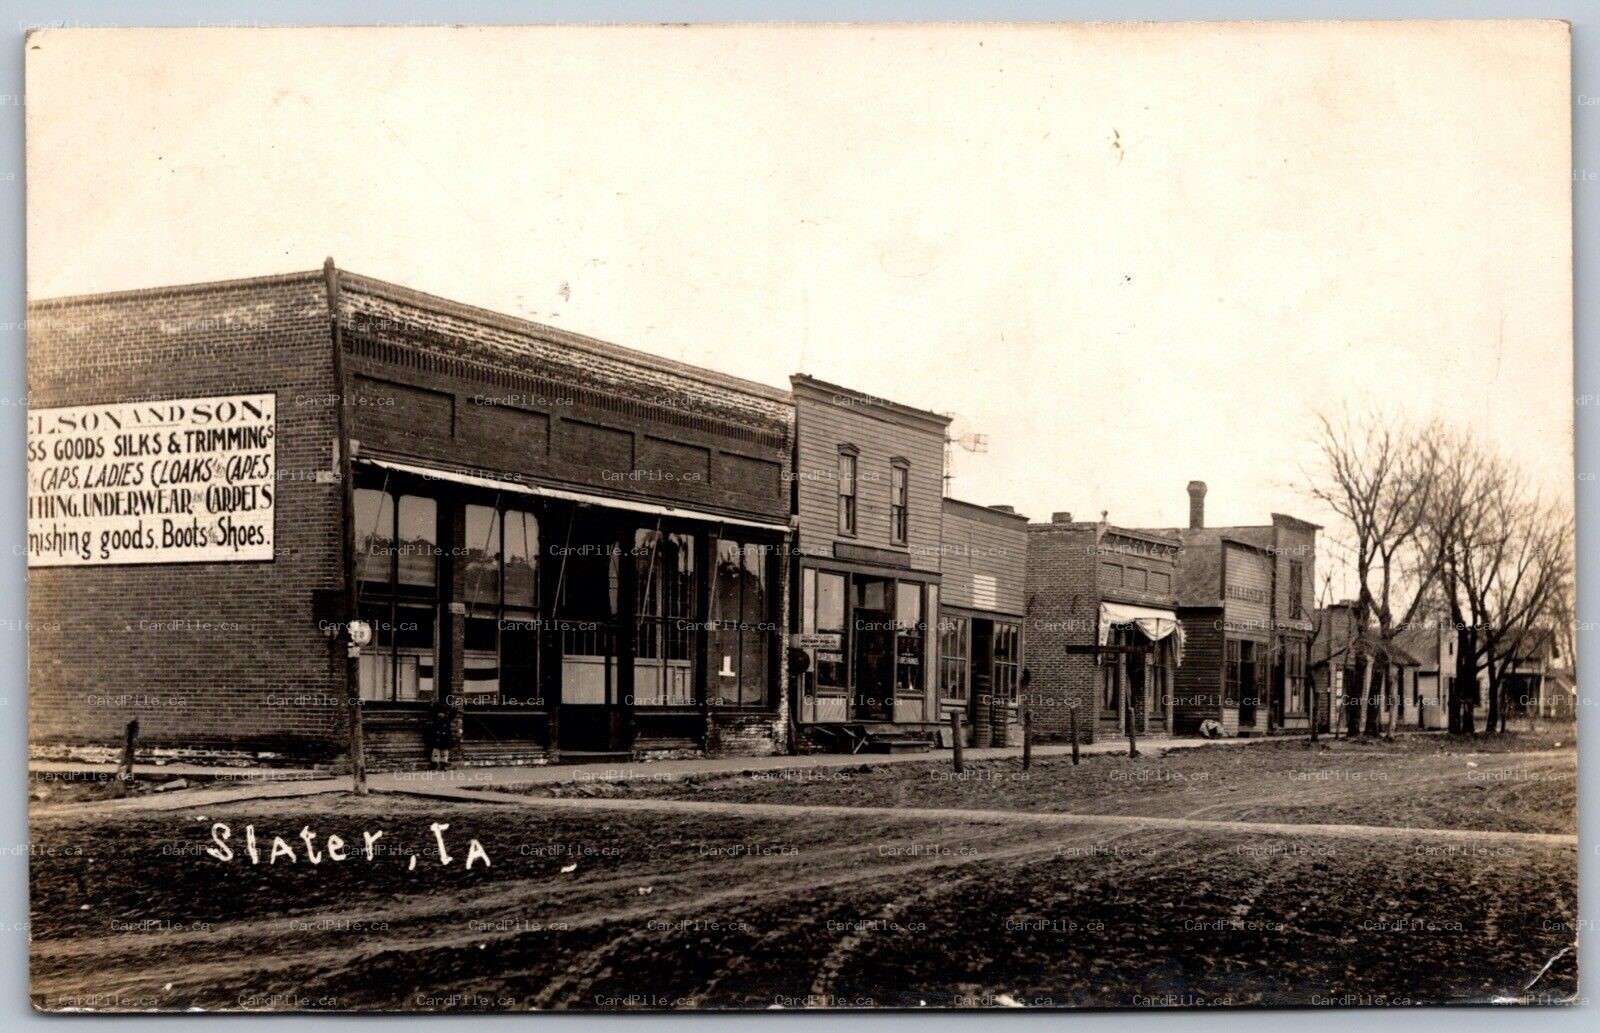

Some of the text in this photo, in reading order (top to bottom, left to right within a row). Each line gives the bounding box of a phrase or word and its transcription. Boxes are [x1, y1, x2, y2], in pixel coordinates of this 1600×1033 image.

[126, 406, 184, 423] AND
[192, 400, 271, 424] SON,
[54, 437, 105, 461] GOODS
[113, 431, 161, 457] SILKS
[167, 432, 181, 453] &
[84, 462, 144, 488] LADIES
[151, 458, 213, 488] CLOAKS
[206, 484, 272, 514] CARPETS
[163, 518, 208, 549] Boots
[217, 515, 271, 552] Shoes.
